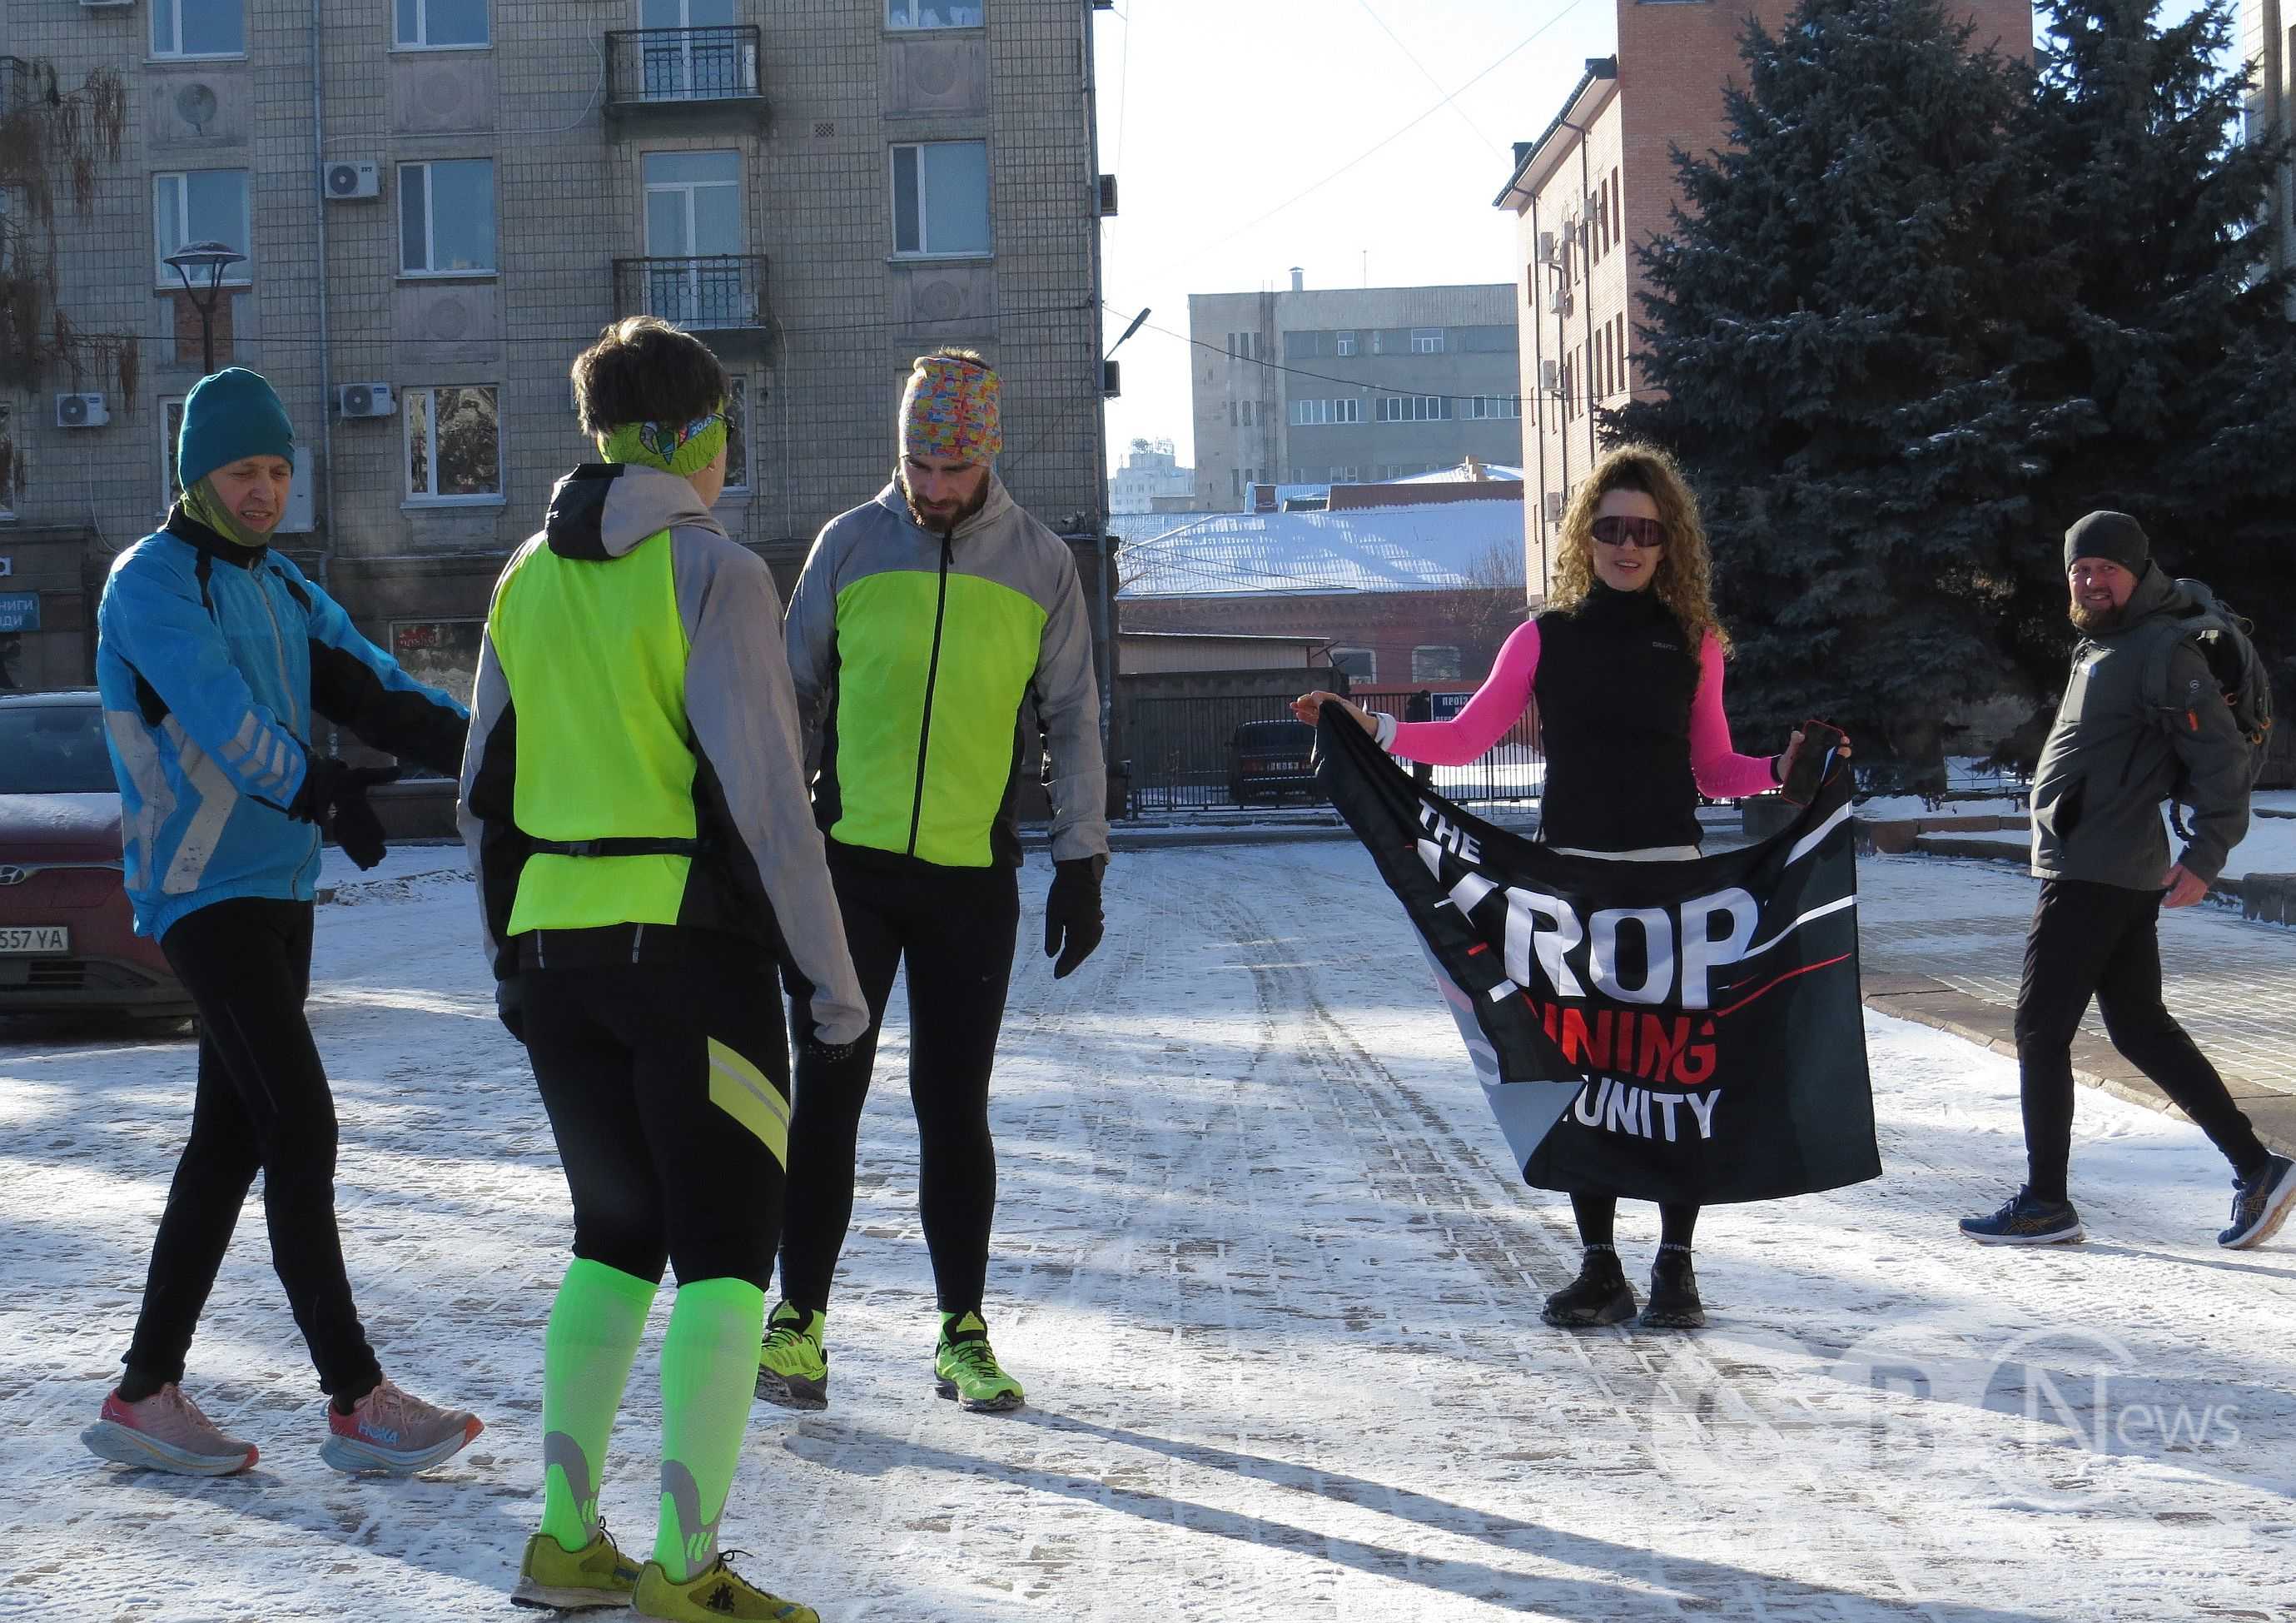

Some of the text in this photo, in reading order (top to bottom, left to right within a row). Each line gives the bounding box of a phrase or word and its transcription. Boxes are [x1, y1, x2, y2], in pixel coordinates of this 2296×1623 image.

[1442, 695, 1472, 706] ПРОЇЗ
[1419, 797, 1481, 864] THE
[1562, 1074, 1722, 1143] UNITY
[359, 1423, 400, 1446] HOKA
